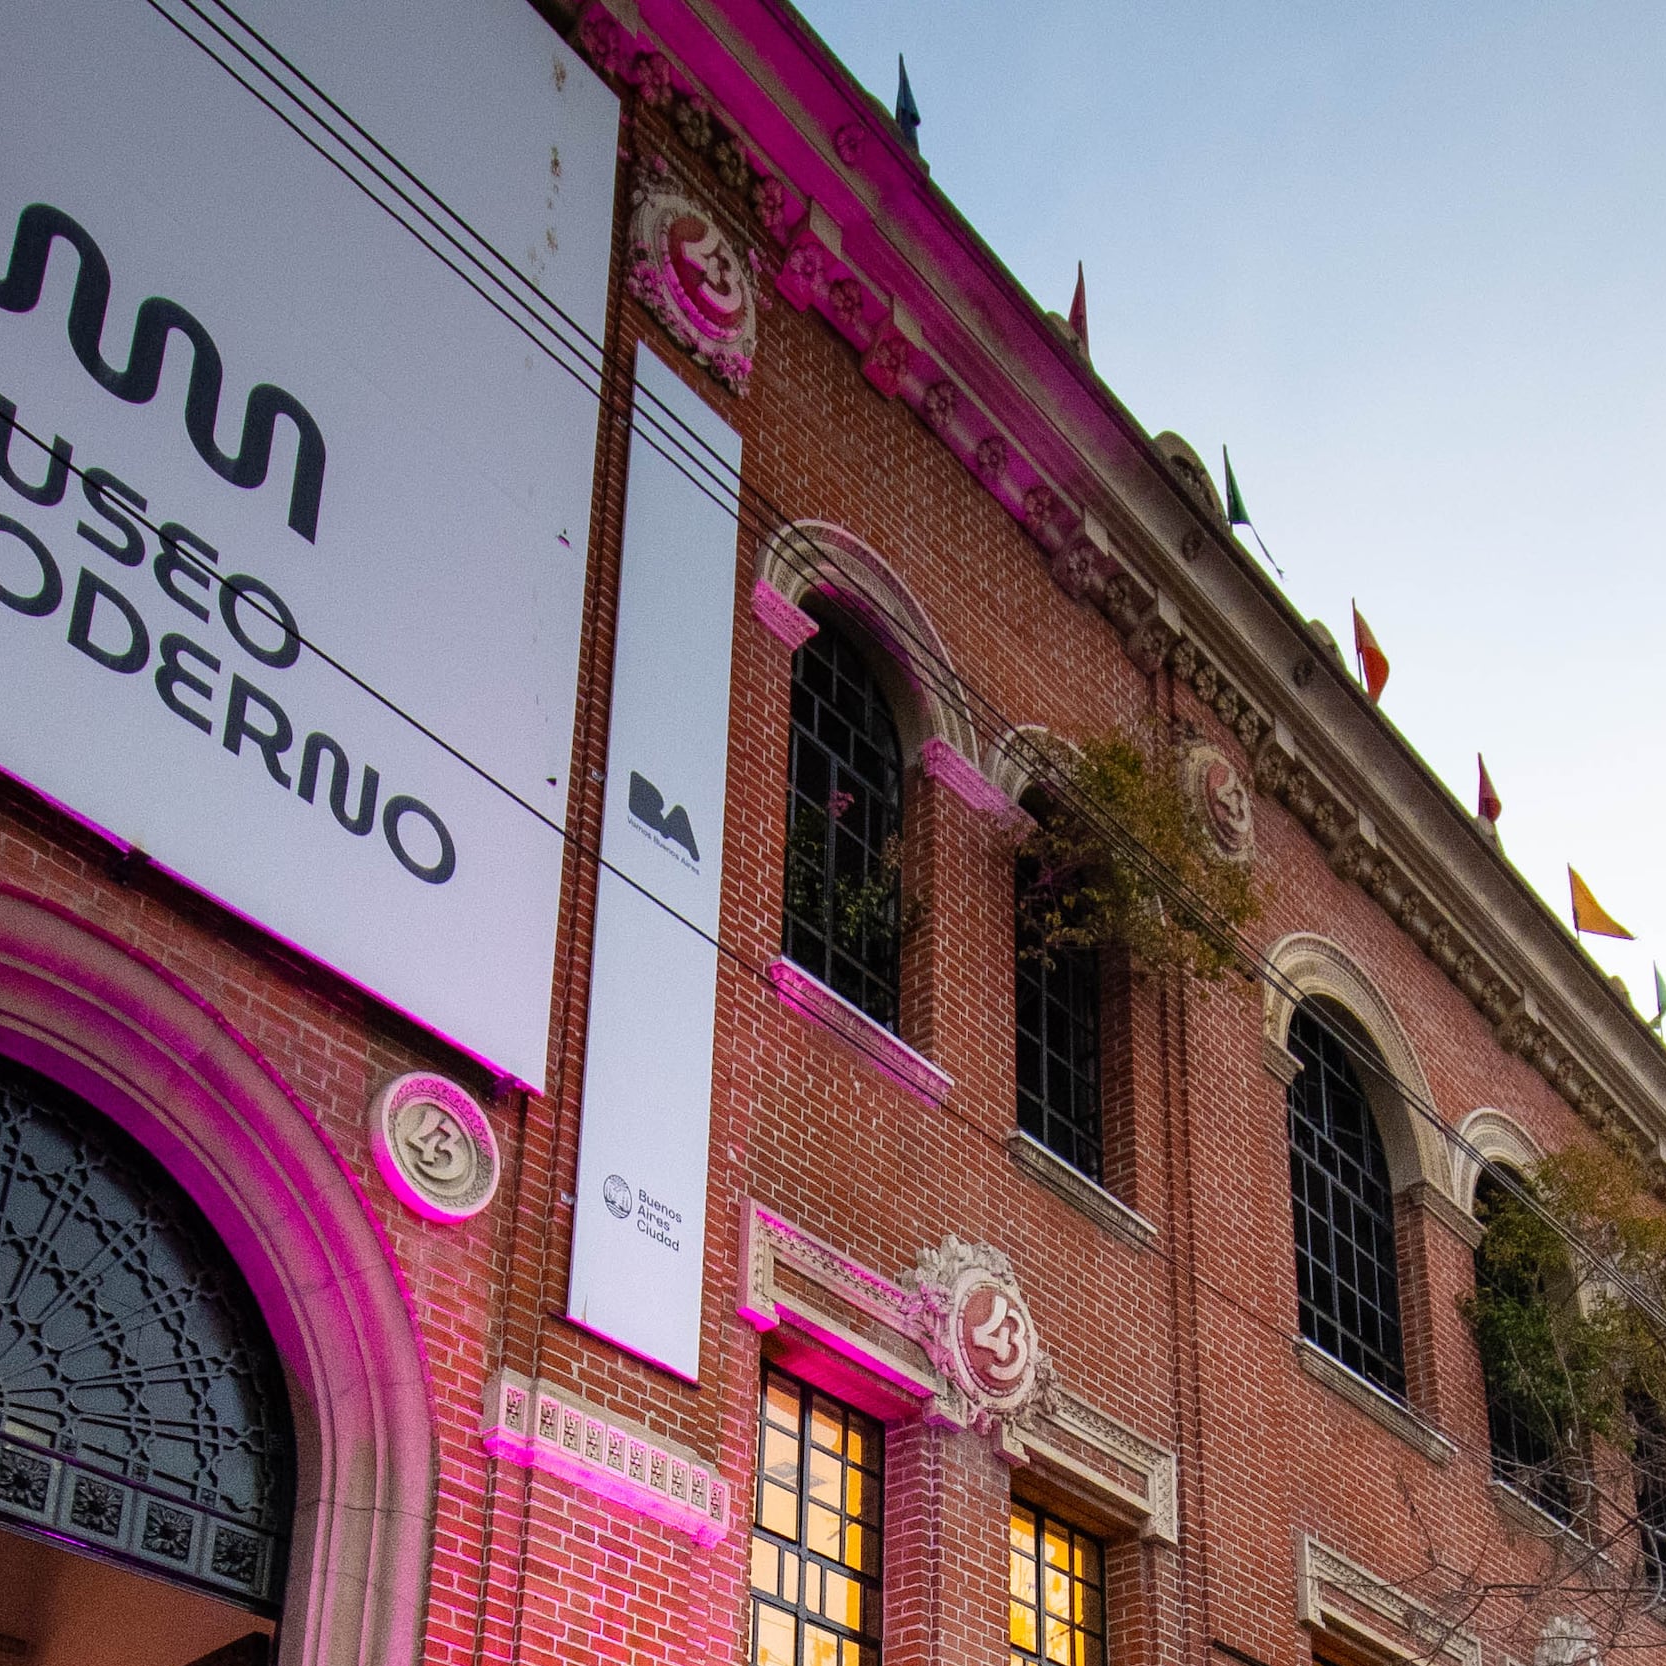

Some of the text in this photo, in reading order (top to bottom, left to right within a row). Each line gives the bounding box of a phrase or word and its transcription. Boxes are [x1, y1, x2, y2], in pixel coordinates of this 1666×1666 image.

[628, 770, 700, 862] BA
[637, 1204, 670, 1231] Aires
[638, 1188, 682, 1224] Buenos
[636, 1219, 680, 1252] Ciudad
[973, 1295, 1028, 1381] 43
